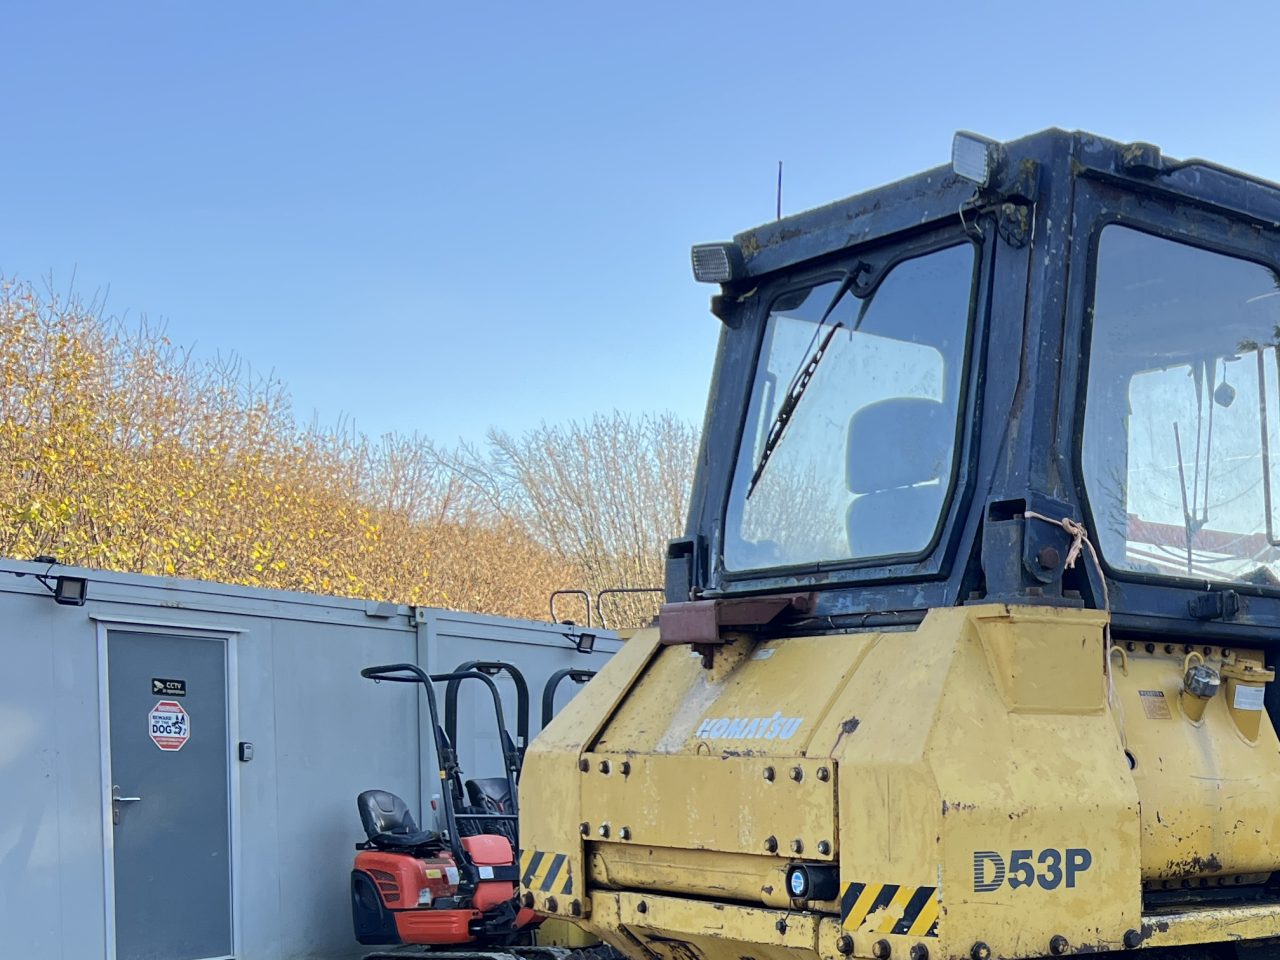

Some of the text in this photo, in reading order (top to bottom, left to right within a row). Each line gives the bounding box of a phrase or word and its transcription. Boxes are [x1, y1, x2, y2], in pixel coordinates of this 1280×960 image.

[152, 724, 172, 734] DOG
[696, 711, 803, 740] KOMATSU
[973, 848, 1092, 893] D53P
